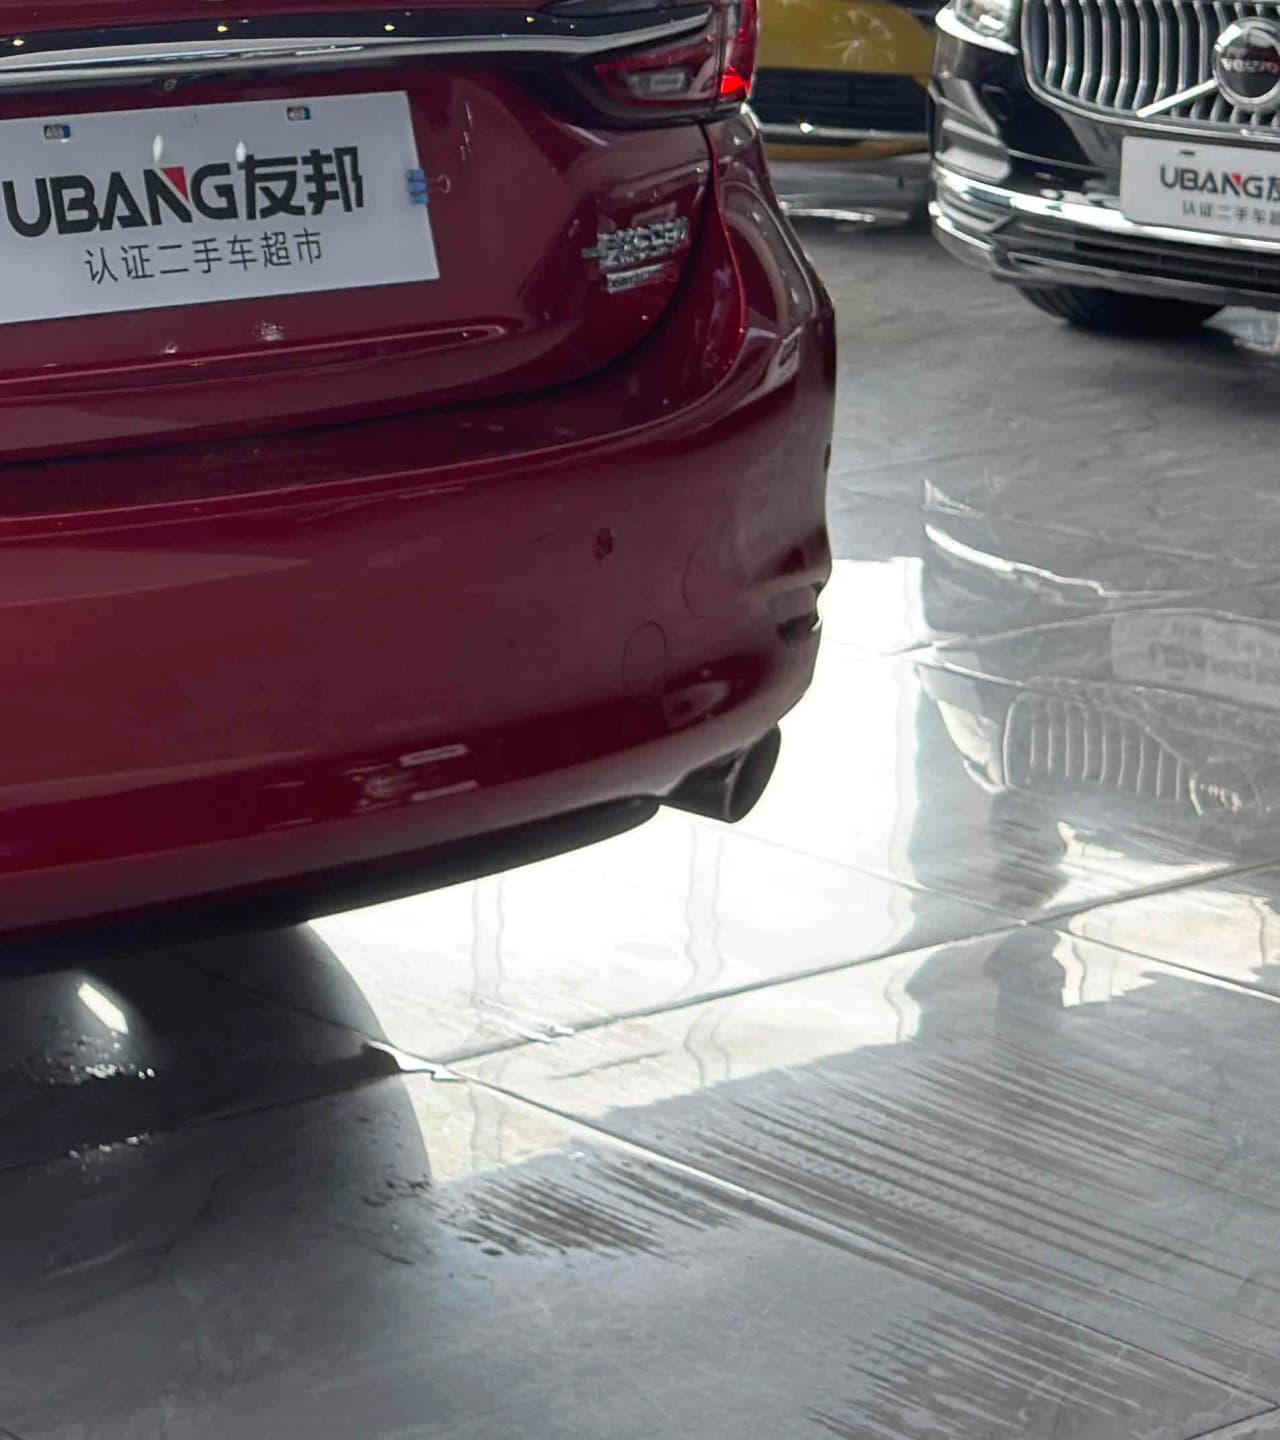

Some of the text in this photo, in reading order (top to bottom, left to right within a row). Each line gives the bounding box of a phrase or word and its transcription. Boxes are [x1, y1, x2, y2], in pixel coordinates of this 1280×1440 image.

[2, 146, 365, 238] UBANG友邦
[84, 228, 323, 284] 认证二手车超市
